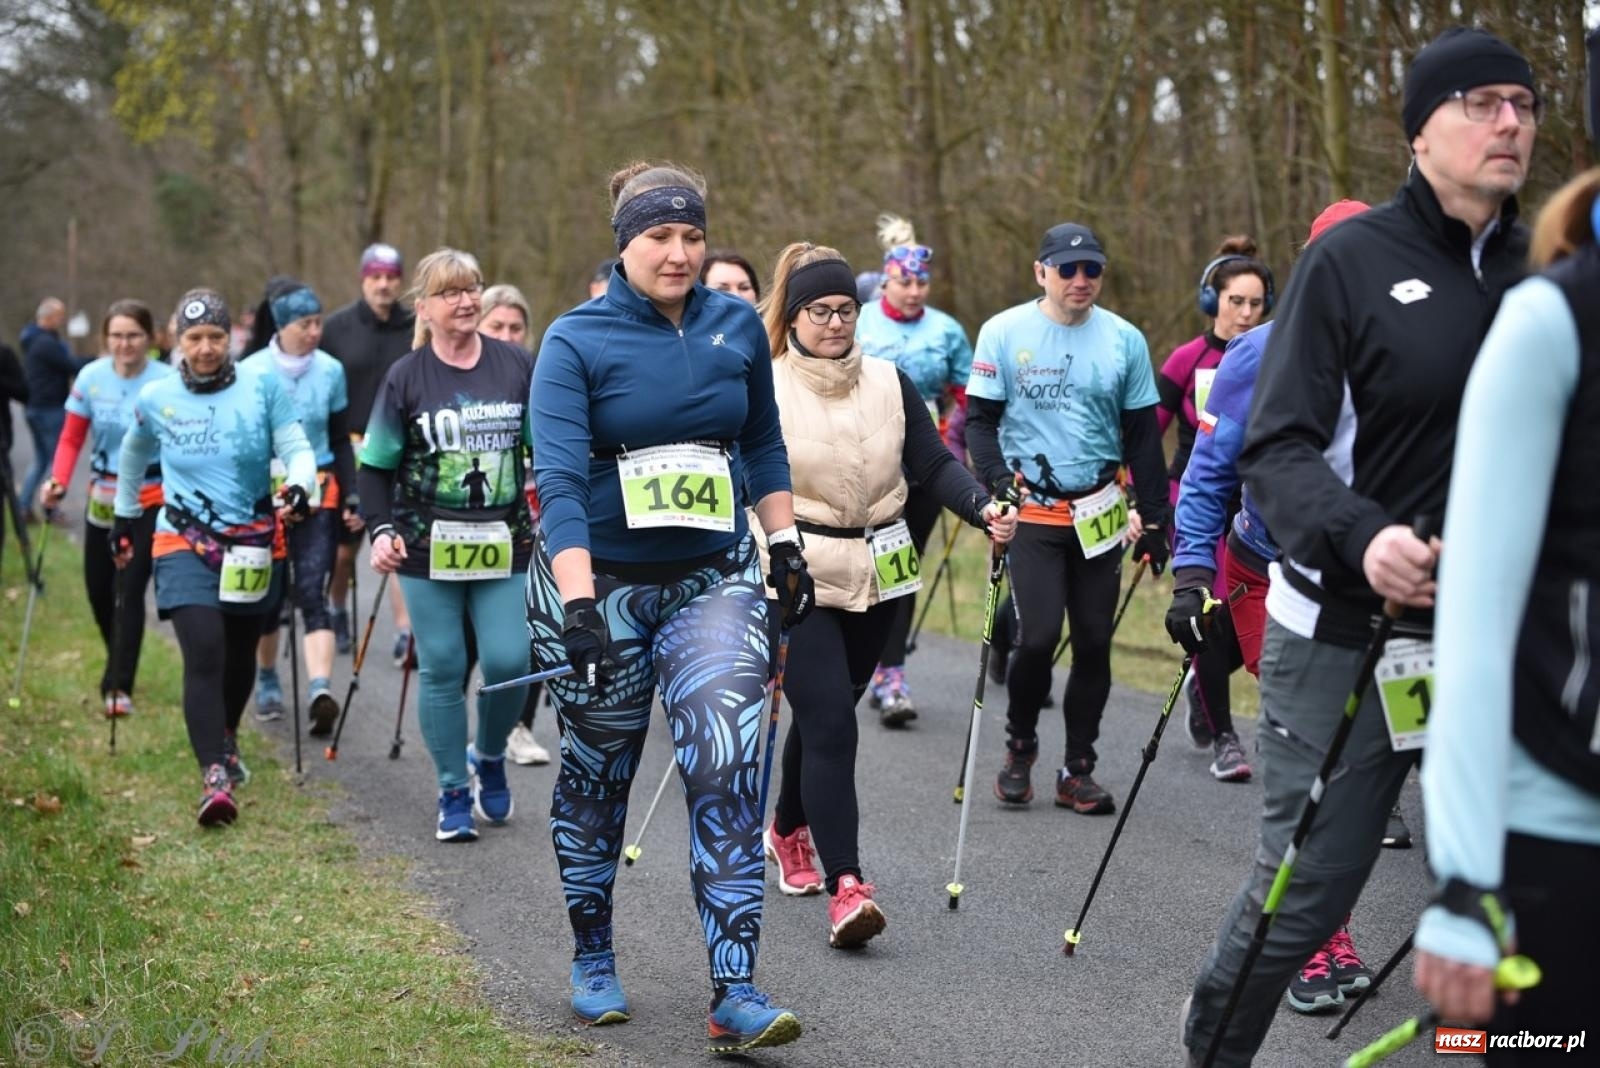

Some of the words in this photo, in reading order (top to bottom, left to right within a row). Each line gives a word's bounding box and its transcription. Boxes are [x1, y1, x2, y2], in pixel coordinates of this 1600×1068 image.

[416, 408, 462, 453] 10
[642, 475, 719, 513] 164
[1090, 504, 1125, 542] 172
[444, 544, 500, 569] 170
[889, 545, 920, 583] 16
